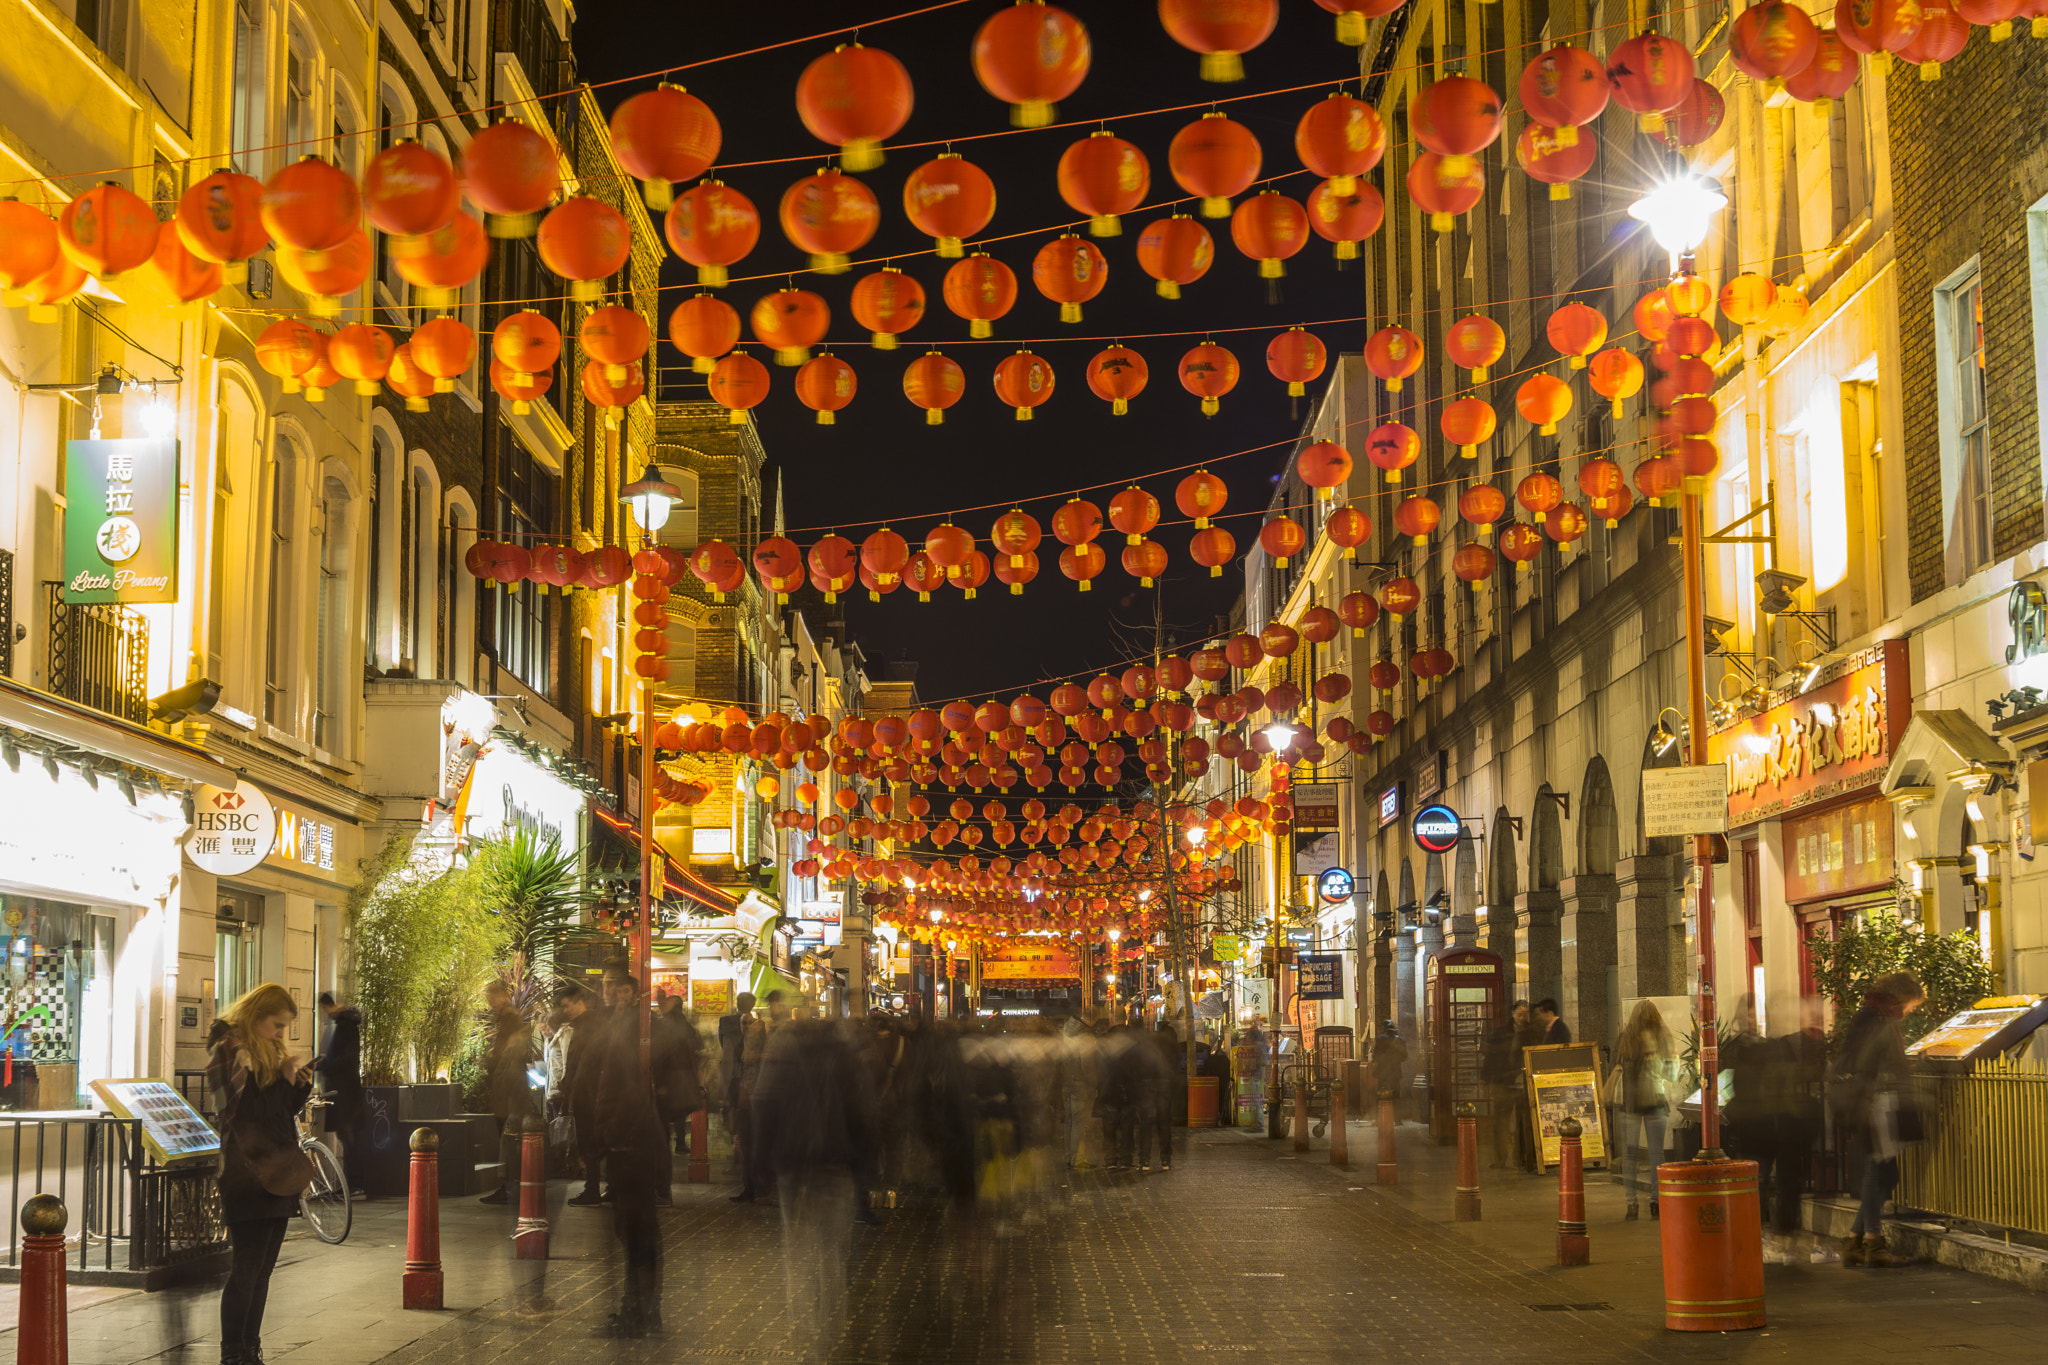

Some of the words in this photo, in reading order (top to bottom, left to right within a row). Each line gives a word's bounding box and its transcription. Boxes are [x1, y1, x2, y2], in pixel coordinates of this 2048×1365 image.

[71, 570, 110, 592] Little
[112, 569, 168, 591] Penang
[197, 812, 259, 832] HSBC
[195, 836, 256, 856] 滙豐
[1301, 973, 1333, 982] MASSAGE
[1447, 965, 1495, 973] TELEPHONE
